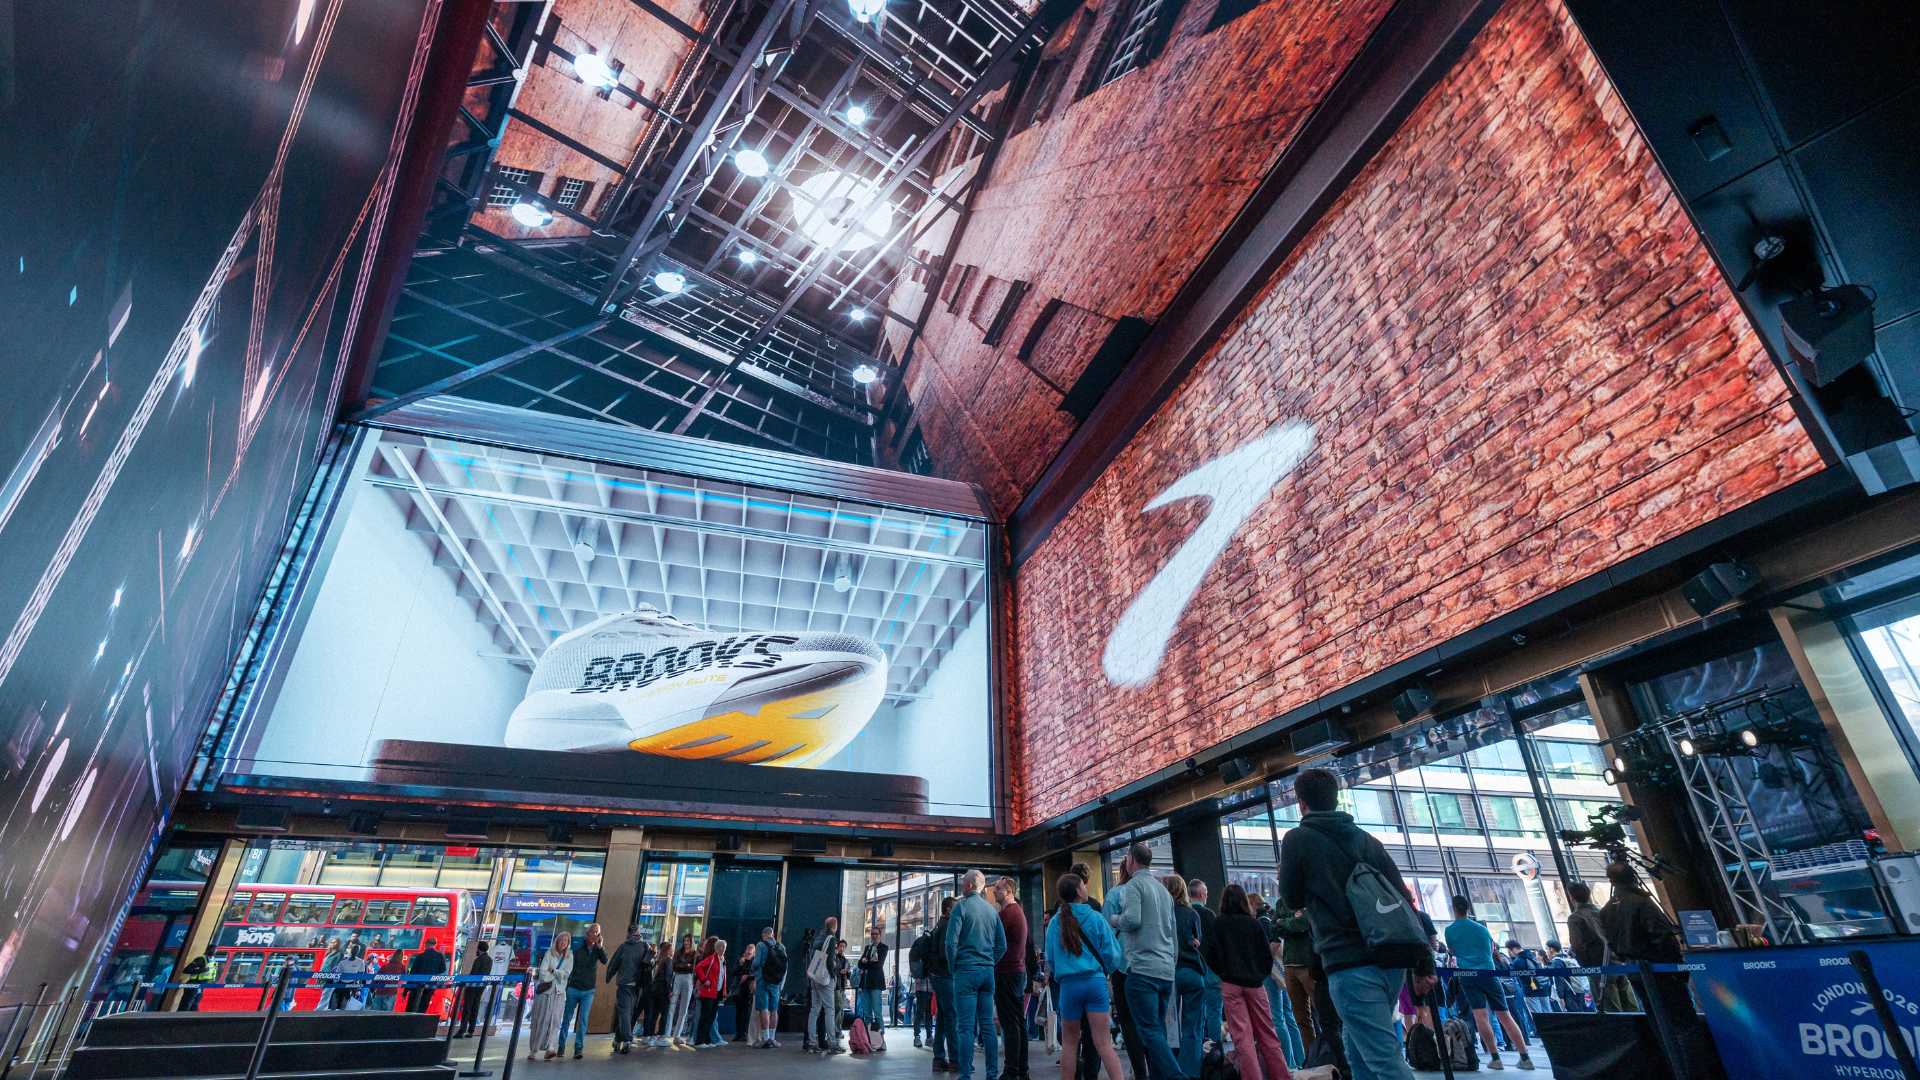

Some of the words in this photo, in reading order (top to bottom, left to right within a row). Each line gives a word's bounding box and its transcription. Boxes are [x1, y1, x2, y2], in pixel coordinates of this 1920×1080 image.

[570, 634, 800, 694] BROOKS
[1743, 961, 1776, 970] BROOKS
[1819, 957, 1852, 966] BROOK
[1677, 963, 1706, 971] BROOKS
[1811, 982, 1868, 1013] LONDON
[1881, 988, 1919, 1015] 026
